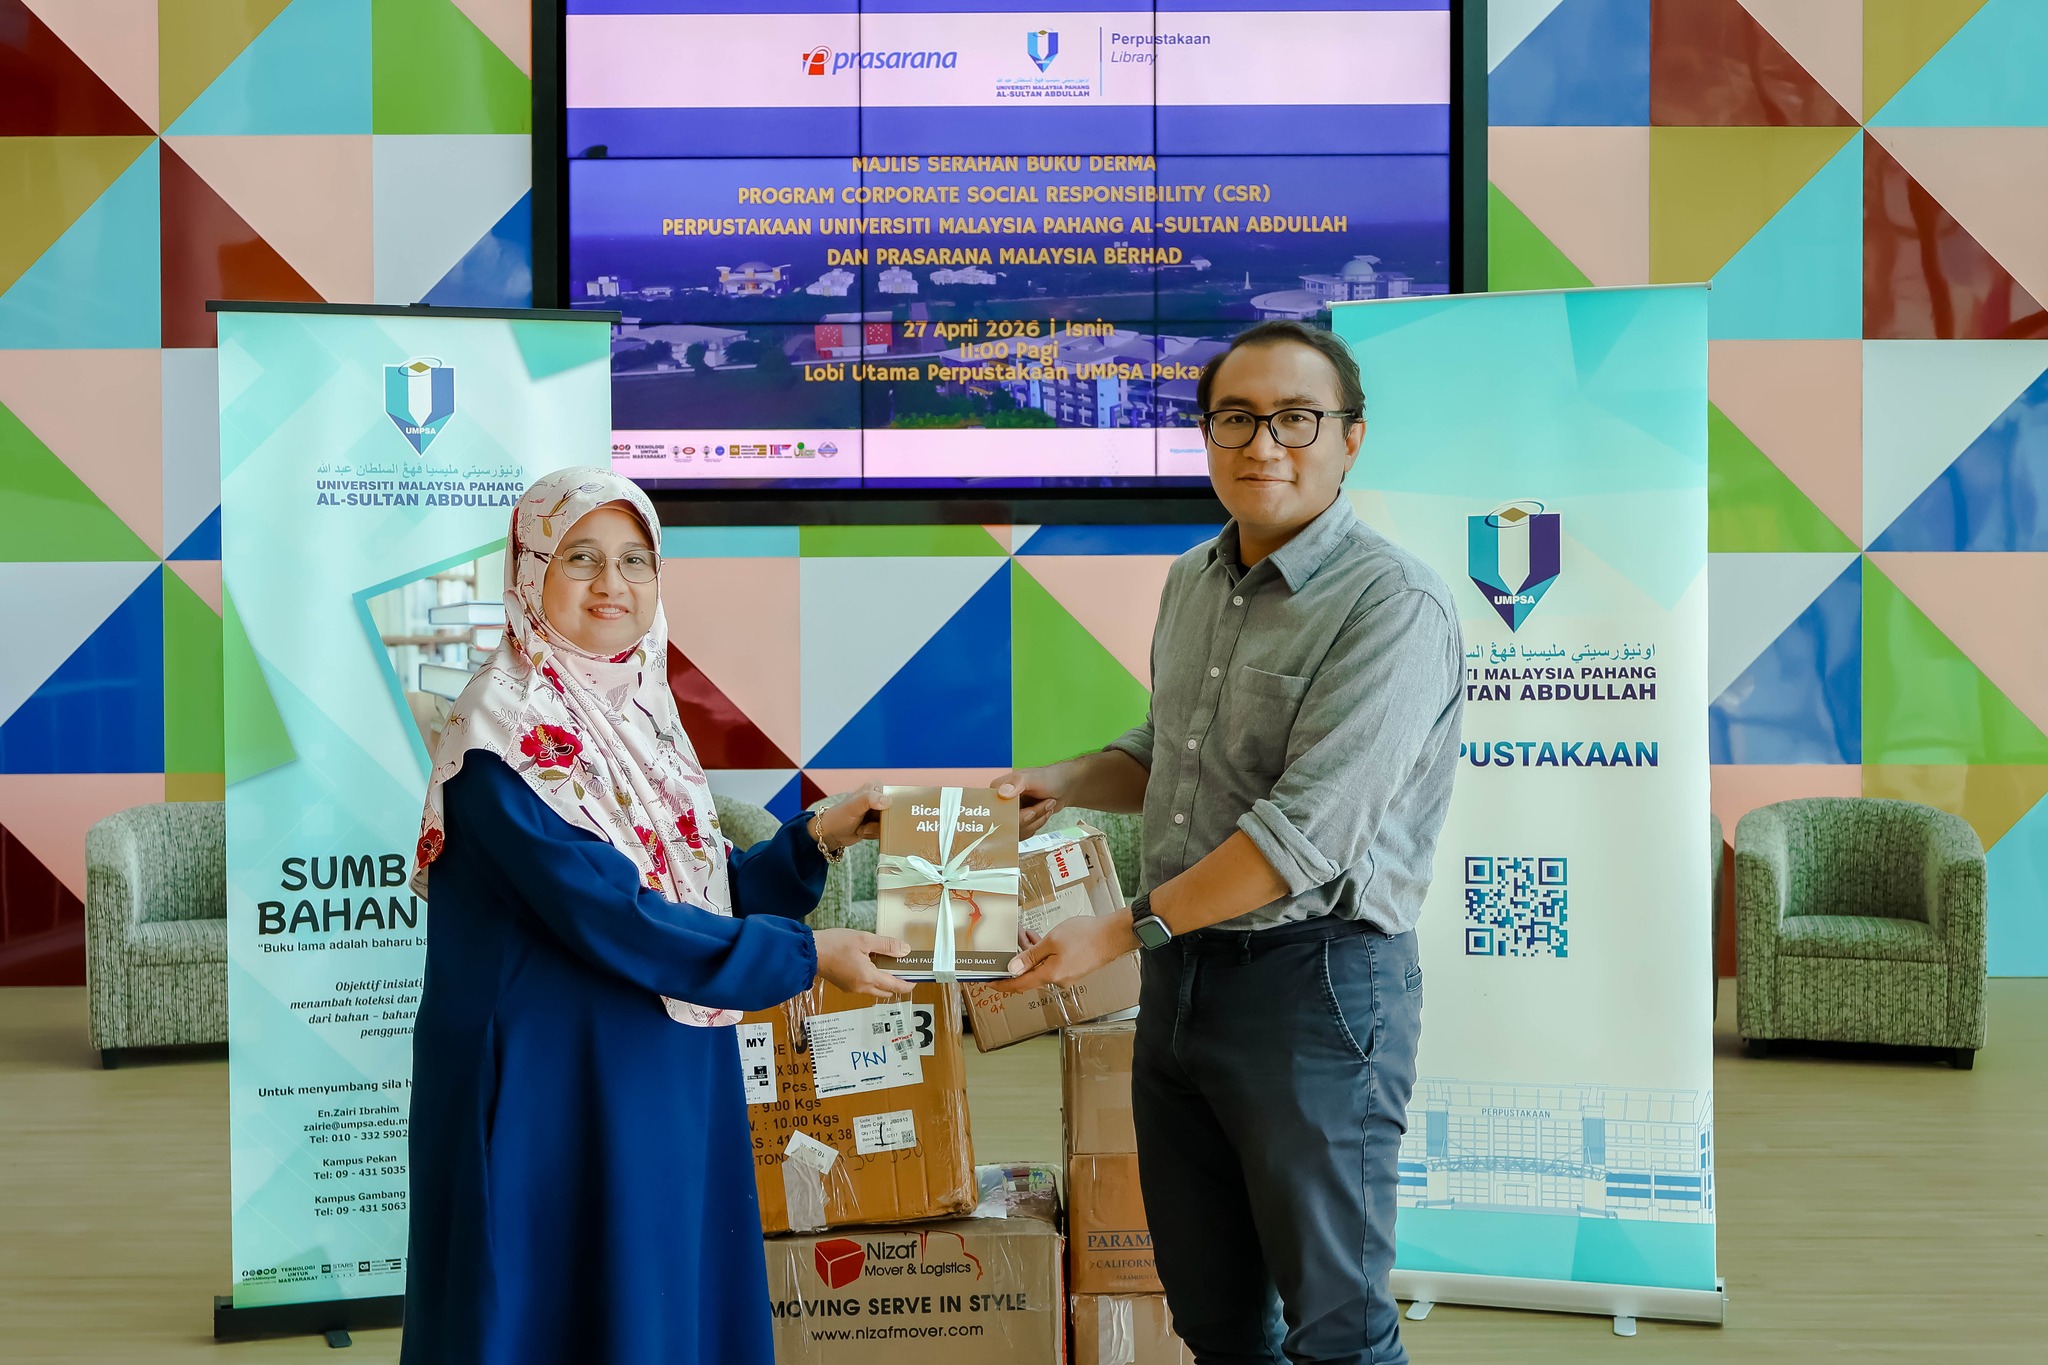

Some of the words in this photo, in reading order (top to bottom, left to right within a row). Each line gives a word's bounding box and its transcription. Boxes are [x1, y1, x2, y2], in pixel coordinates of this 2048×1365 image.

[1111, 32, 1211, 47] Perpustakaan
[832, 48, 958, 75] prasarana
[1111, 51, 1158, 67] Library
[852, 156, 920, 173] MAJLIS
[928, 156, 1018, 172] SERAHAN
[1027, 156, 1081, 172] BUKU
[1089, 156, 1156, 172] DERMA
[738, 187, 834, 204] PROGRAM
[842, 186, 959, 203] CORPORATE
[967, 186, 1038, 203] SOCIAL
[1046, 185, 1206, 203] RESPONSIBILITY
[1213, 184, 1271, 202] (CSR)
[662, 218, 811, 236] PERPUSTAKAAN
[820, 217, 930, 235] UNIVERSITI
[939, 217, 1036, 235] MALAYSIA
[1044, 217, 1124, 234] PAHANG
[1130, 216, 1239, 233] AL-SULTAN
[1246, 215, 1348, 233] ABDULLAH
[827, 248, 868, 266] DAN
[877, 248, 992, 265] PRASARANA
[1000, 248, 1096, 265] MALAYSIA
[1104, 247, 1183, 265] BERHAD
[903, 320, 926, 338] 27
[933, 319, 978, 341] April
[985, 320, 1040, 338] 2026
[1066, 318, 1114, 338] Isnin
[960, 342, 1009, 359] 11:00
[1016, 341, 1059, 364] Pagi
[804, 364, 844, 382] Lobi
[852, 364, 920, 381] Utama
[928, 364, 1068, 384] Perpustakaan
[1076, 364, 1144, 380] UMPSA
[1151, 361, 1200, 380] Peka
[405, 427, 436, 435] UMPSA
[316, 480, 394, 491] UNIVERSITI
[398, 481, 465, 491] MALAYSIA
[469, 482, 524, 491] PAHANG
[316, 493, 419, 506] AL-SULTAN
[425, 493, 521, 507] ABDULLAH
[1494, 595, 1535, 605] UMPSA
[1485, 667, 1575, 680] MALAYSIA
[1581, 666, 1656, 679] PAHANG
[1520, 683, 1656, 700] ABDULLAH
[911, 804, 940, 816] Bica
[958, 805, 991, 816] Pada
[916, 820, 940, 832] Akh
[957, 820, 984, 832] Usia
[258, 896, 418, 935] BAHAN
[298, 941, 325, 951] lama
[329, 939, 368, 950] adalah
[372, 937, 412, 947] baharu
[335, 979, 382, 993] Objektif
[383, 978, 424, 990] inisiati
[290, 996, 352, 1010] menambah
[355, 994, 394, 1006] koleksi
[397, 993, 418, 1004] dan
[309, 1012, 331, 1024] dari
[335, 1011, 369, 1023] bahan
[382, 1010, 416, 1020] bahan
[360, 1025, 414, 1039] pengguna
[746, 1037, 766, 1048] MY
[851, 1045, 887, 1070] PKN
[787, 1063, 798, 1075] 30
[258, 1086, 294, 1098] Untuk
[298, 1081, 378, 1097] menyumbang
[381, 1079, 402, 1089] sila
[782, 1082, 812, 1093] Pcs.
[318, 1107, 356, 1118] En.Zairi
[359, 1105, 400, 1116] Ibrahim
[762, 1100, 790, 1113] 9.00
[795, 1098, 822, 1112] Kgs
[1481, 1107, 1551, 1119] PERPUSTAKAAN
[773, 1116, 808, 1129] 10.00
[813, 1114, 839, 1127] Kgs
[309, 1134, 329, 1144] Tel:
[332, 1133, 351, 1143] 010
[361, 1131, 380, 1140] 332
[383, 1129, 408, 1139] 5902
[838, 1129, 852, 1141] 38
[322, 1157, 363, 1169] Kampus
[366, 1154, 397, 1164] Pekan
[313, 1170, 333, 1180] Tel:
[335, 1169, 349, 1179] 09
[358, 1167, 378, 1177] 431
[381, 1165, 406, 1175] 5035
[315, 1193, 355, 1205] Kampus
[358, 1189, 406, 1202] Gambang
[314, 1207, 333, 1217] Tel:
[336, 1206, 349, 1215] 09
[359, 1204, 378, 1214] 431
[381, 1202, 407, 1212] 5063
[866, 1241, 918, 1261] Nizaf
[865, 1264, 905, 1277] Mover
[907, 1263, 917, 1276] &
[920, 1262, 971, 1279] Logistics
[770, 1299, 860, 1319] MOVING
[867, 1296, 932, 1316] SERVE
[940, 1295, 963, 1314] IN
[970, 1293, 1027, 1312] STYLE
[811, 1323, 984, 1342] www.nizafmover.com
